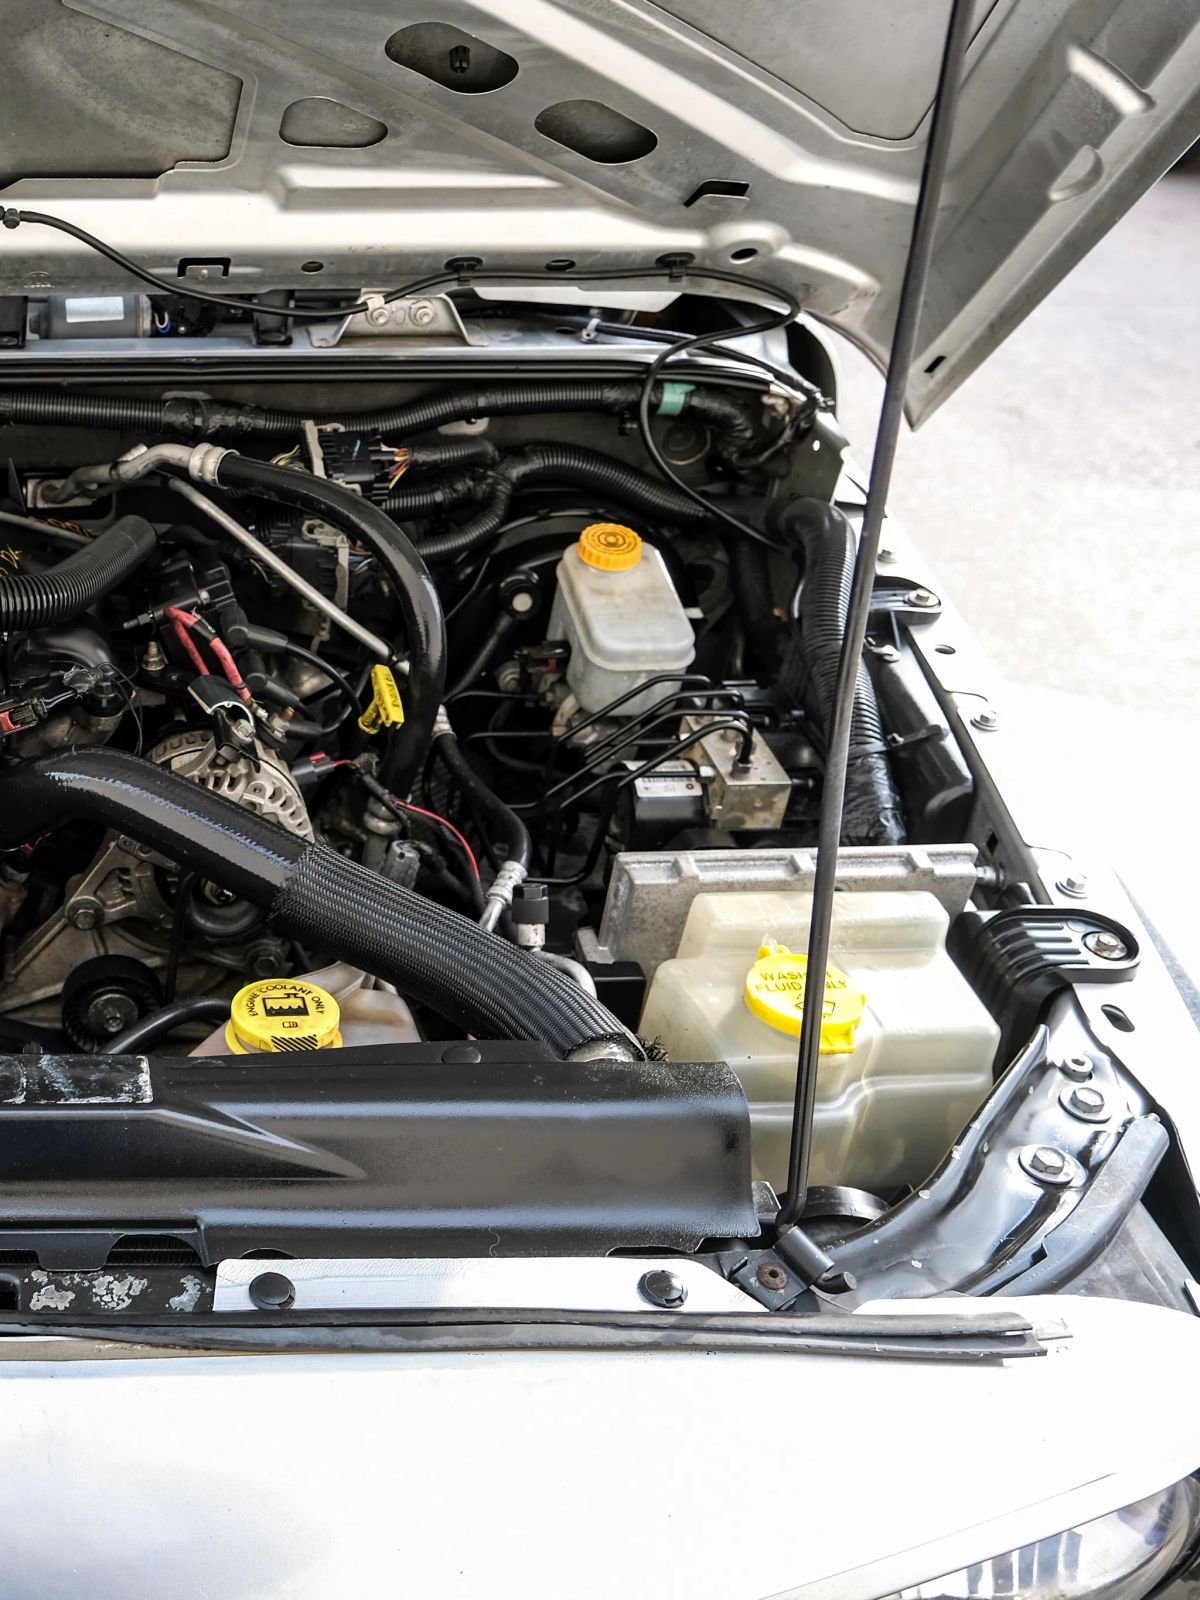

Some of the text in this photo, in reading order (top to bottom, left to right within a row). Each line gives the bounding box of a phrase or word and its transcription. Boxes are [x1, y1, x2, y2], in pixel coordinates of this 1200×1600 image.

[760, 970, 832, 981] WASH
[754, 981, 802, 992] FLUID
[246, 984, 325, 1016] ENGINE COOLANT ONLY
